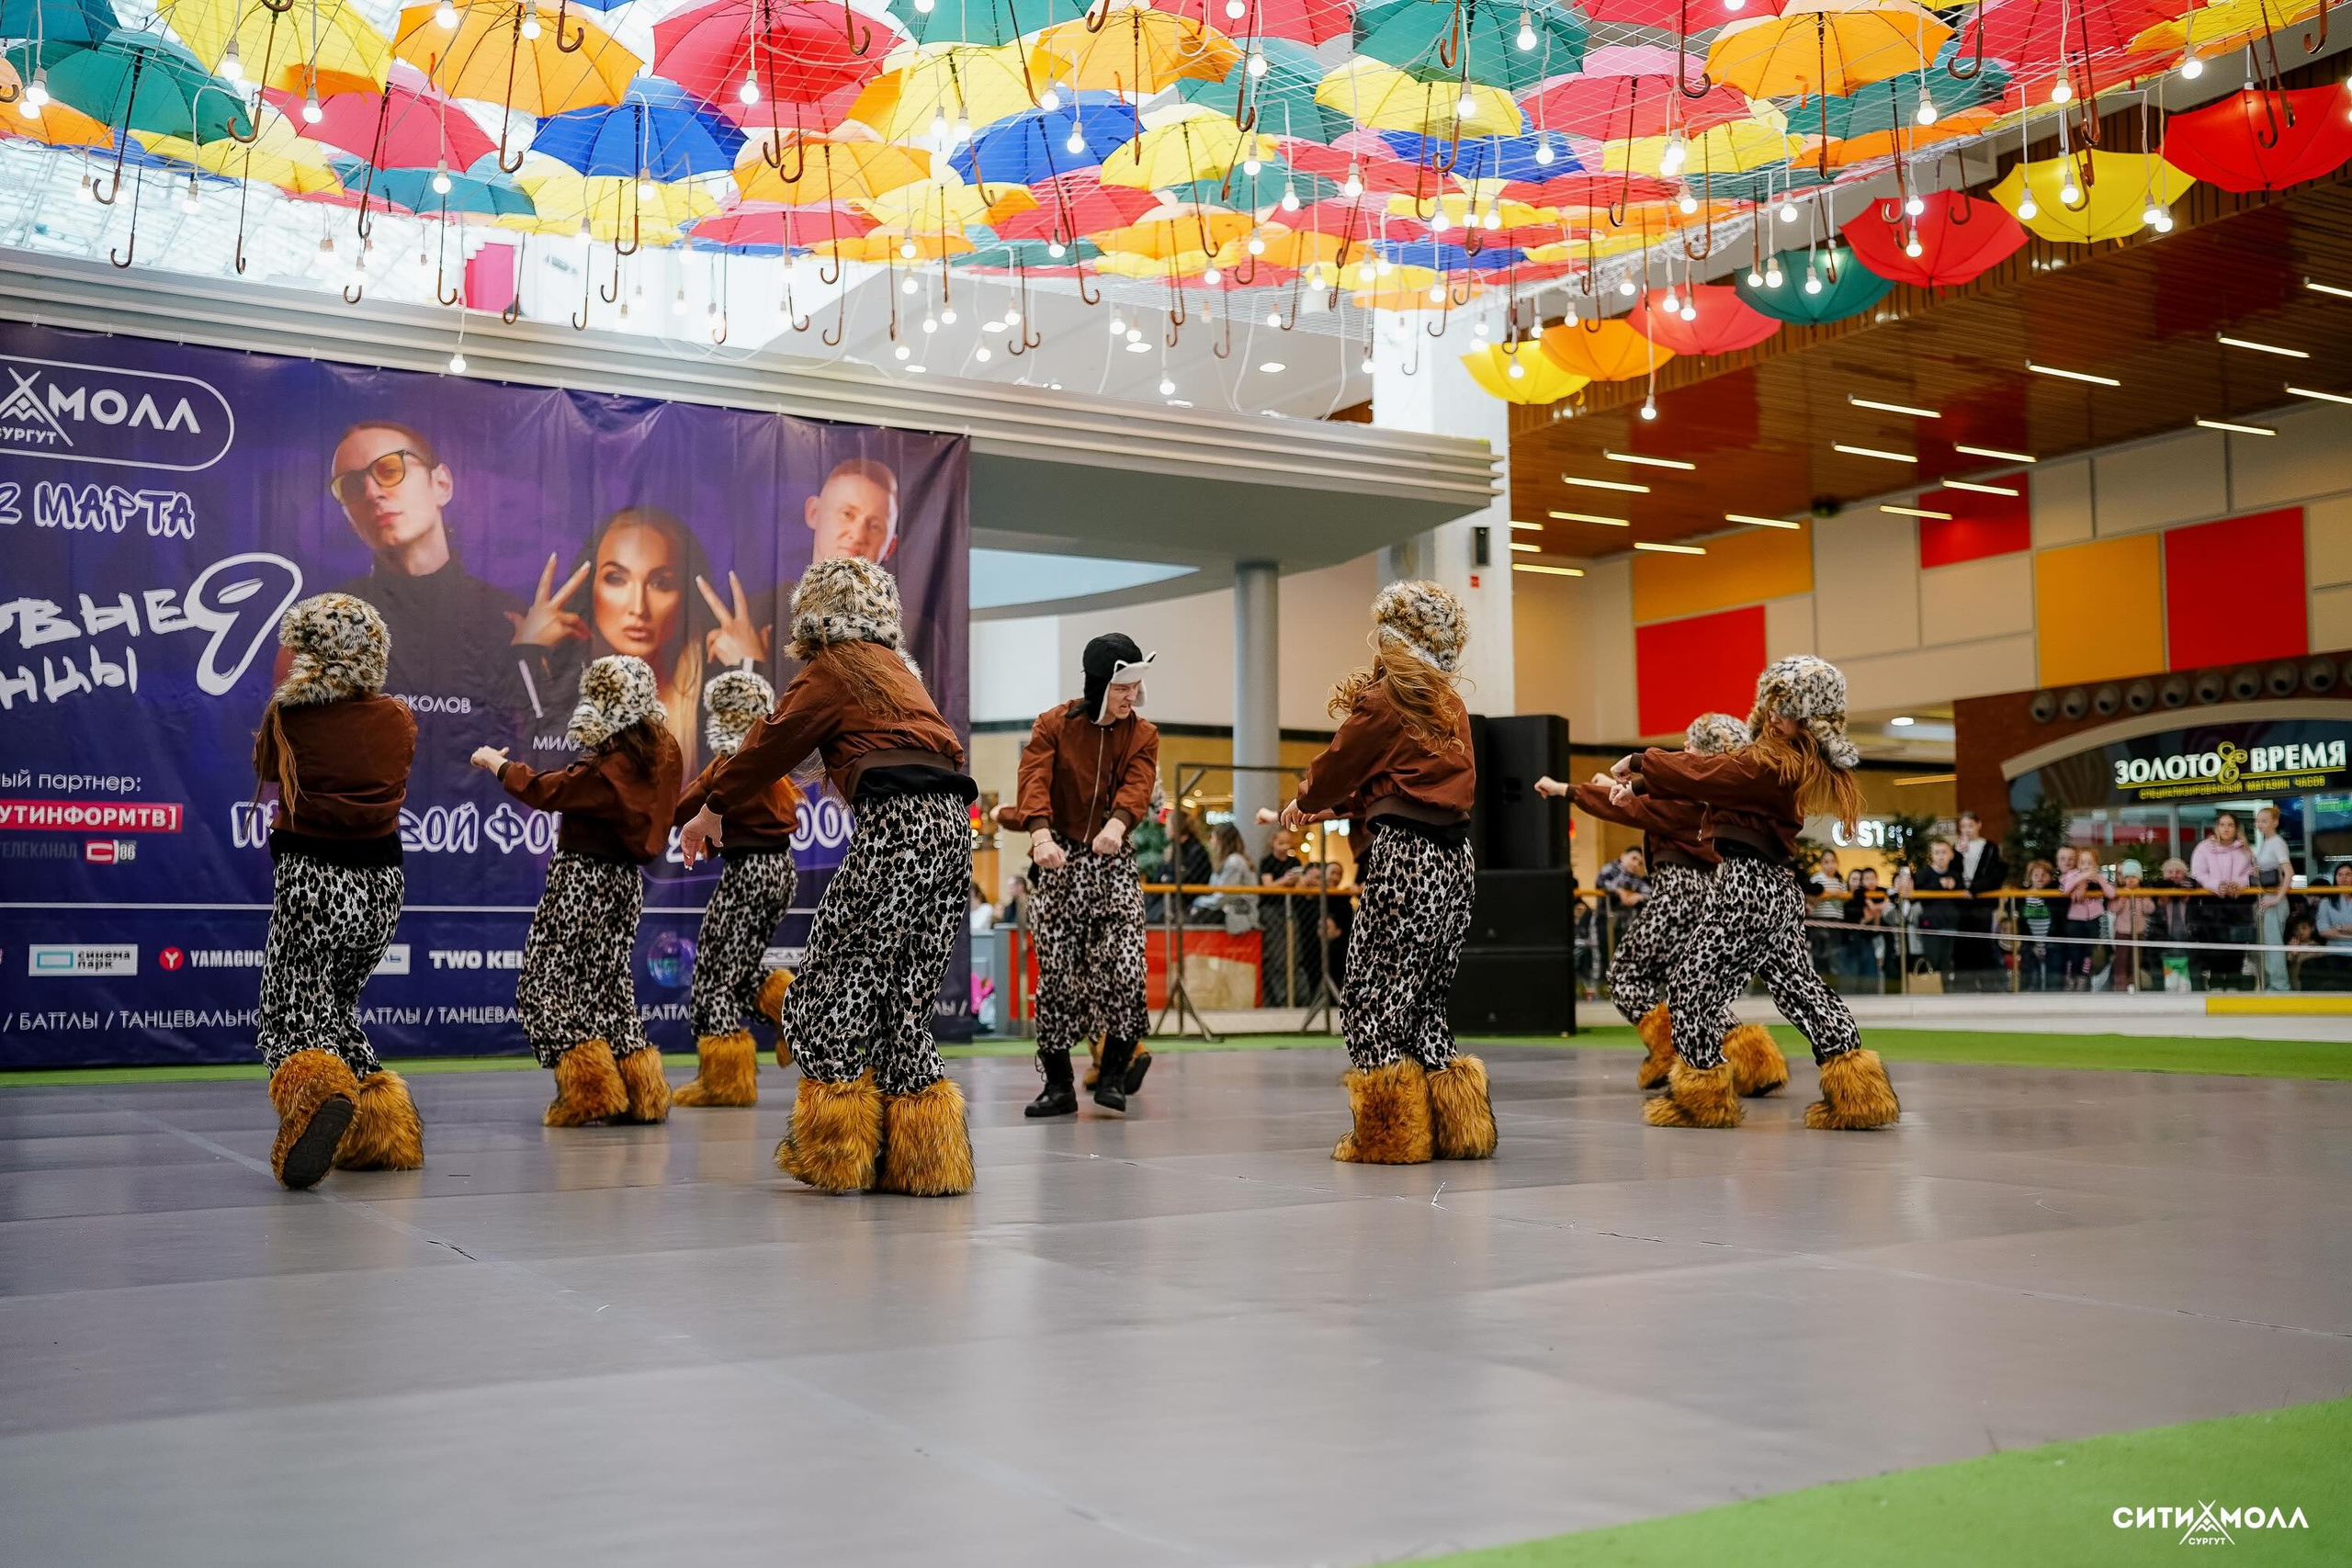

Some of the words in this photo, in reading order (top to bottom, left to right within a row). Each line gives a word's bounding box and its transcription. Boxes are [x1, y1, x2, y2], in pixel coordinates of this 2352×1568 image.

[49, 383, 200, 434] МОЛЛ
[0, 426, 57, 445] УРГУТ
[34, 480, 196, 540] МАРТА
[379, 693, 471, 714] КОЛОВ
[2250, 740, 2346, 773] ВРЕМЯ
[0, 769, 30, 787] ый
[39, 774, 141, 795] партнер:
[429, 950, 483, 969] TWO
[19, 1012, 98, 1030] БАТТЛЫ
[642, 1003, 690, 1021] БАТТЛ
